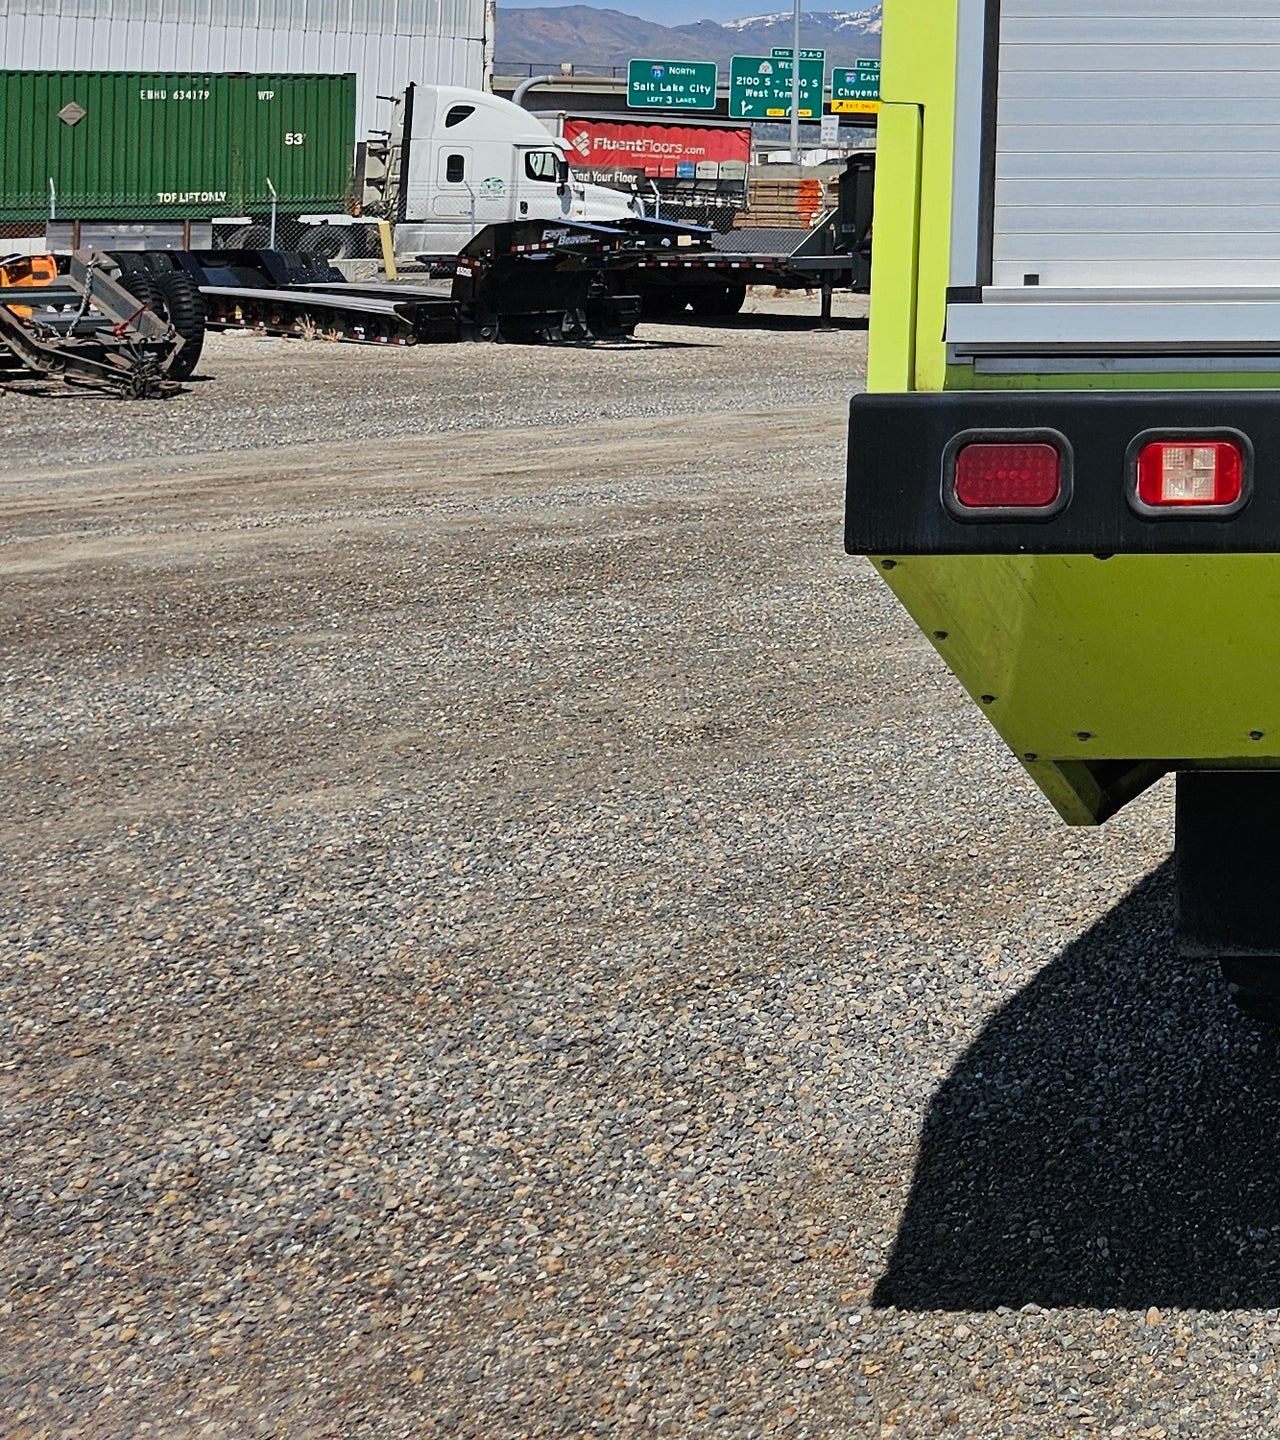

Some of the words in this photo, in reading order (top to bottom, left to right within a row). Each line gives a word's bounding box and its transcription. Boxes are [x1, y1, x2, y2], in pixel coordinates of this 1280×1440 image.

[778, 61, 793, 69] WES
[668, 66, 696, 75] NORTH
[736, 76, 759, 85] 2100
[764, 77, 771, 86] S
[784, 78, 807, 87] 130
[811, 79, 818, 88] S
[860, 73, 880, 81] EAST
[633, 82, 655, 91] Salt
[660, 83, 684, 92] Lake
[689, 84, 711, 95] City
[745, 88, 768, 97] West
[773, 88, 809, 99] Temle
[838, 88, 880, 98] Cheyenn
[173, 90, 210, 100] 634179
[257, 91, 275, 100] WTP
[666, 95, 672, 104] 3
[593, 137, 706, 156] FluentFloors.com
[592, 170, 614, 183] Your
[614, 171, 638, 184] Floor
[201, 191, 227, 202] ONLY
